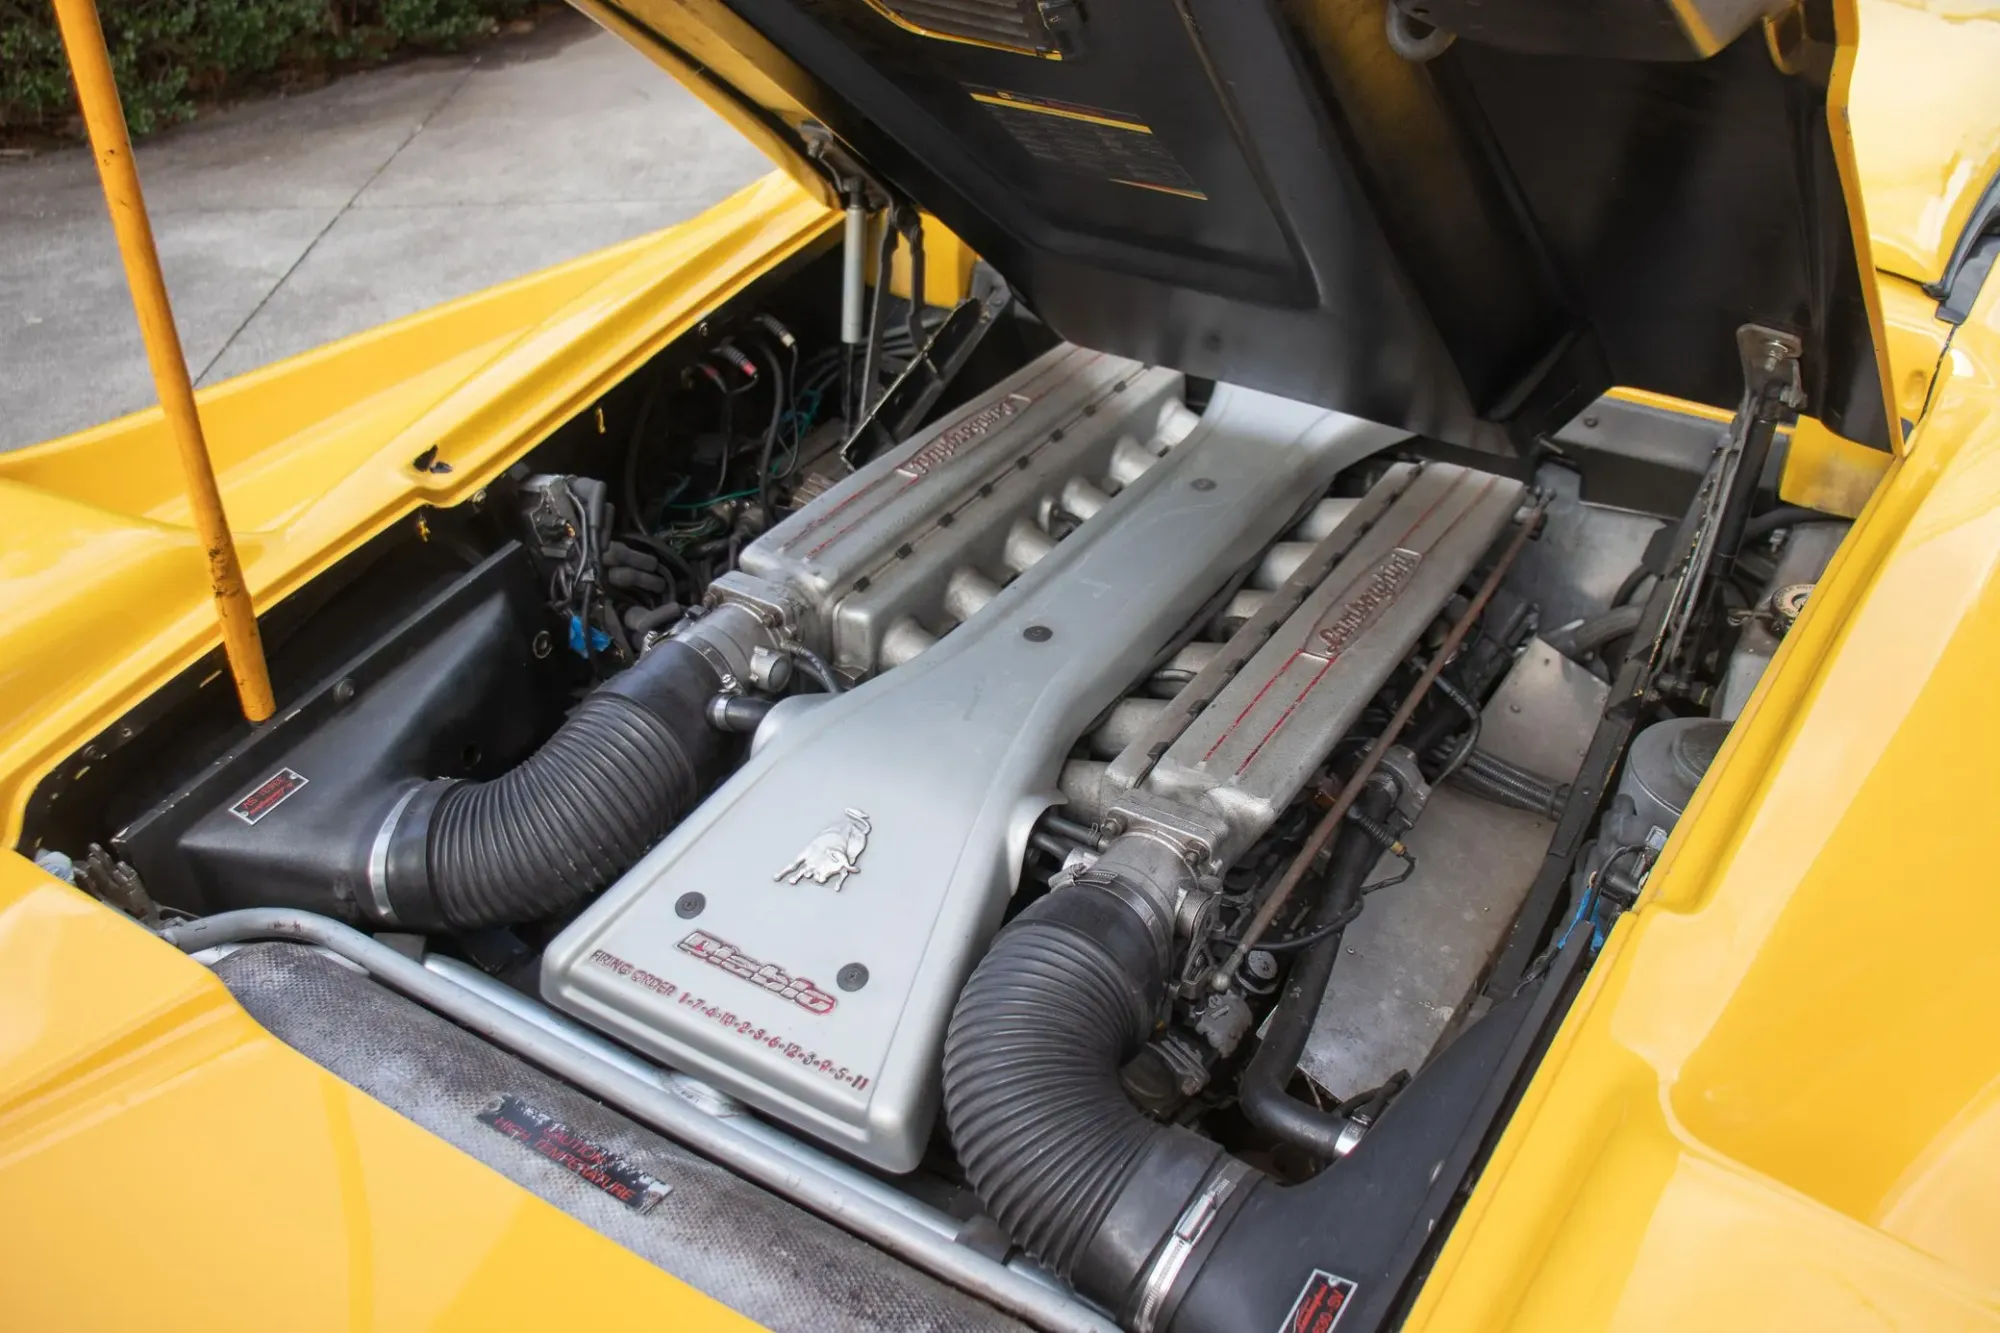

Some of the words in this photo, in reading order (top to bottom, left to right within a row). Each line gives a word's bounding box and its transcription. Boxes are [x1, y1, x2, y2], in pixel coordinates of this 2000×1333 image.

[1318, 553, 1415, 656] Lamborghini
[590, 949, 634, 976] FIRING
[631, 969, 677, 996] ORDER
[494, 1116, 532, 1141] HIGH
[535, 1138, 637, 1201] TEMPERATURE
[543, 1127, 607, 1165] CAUTION
